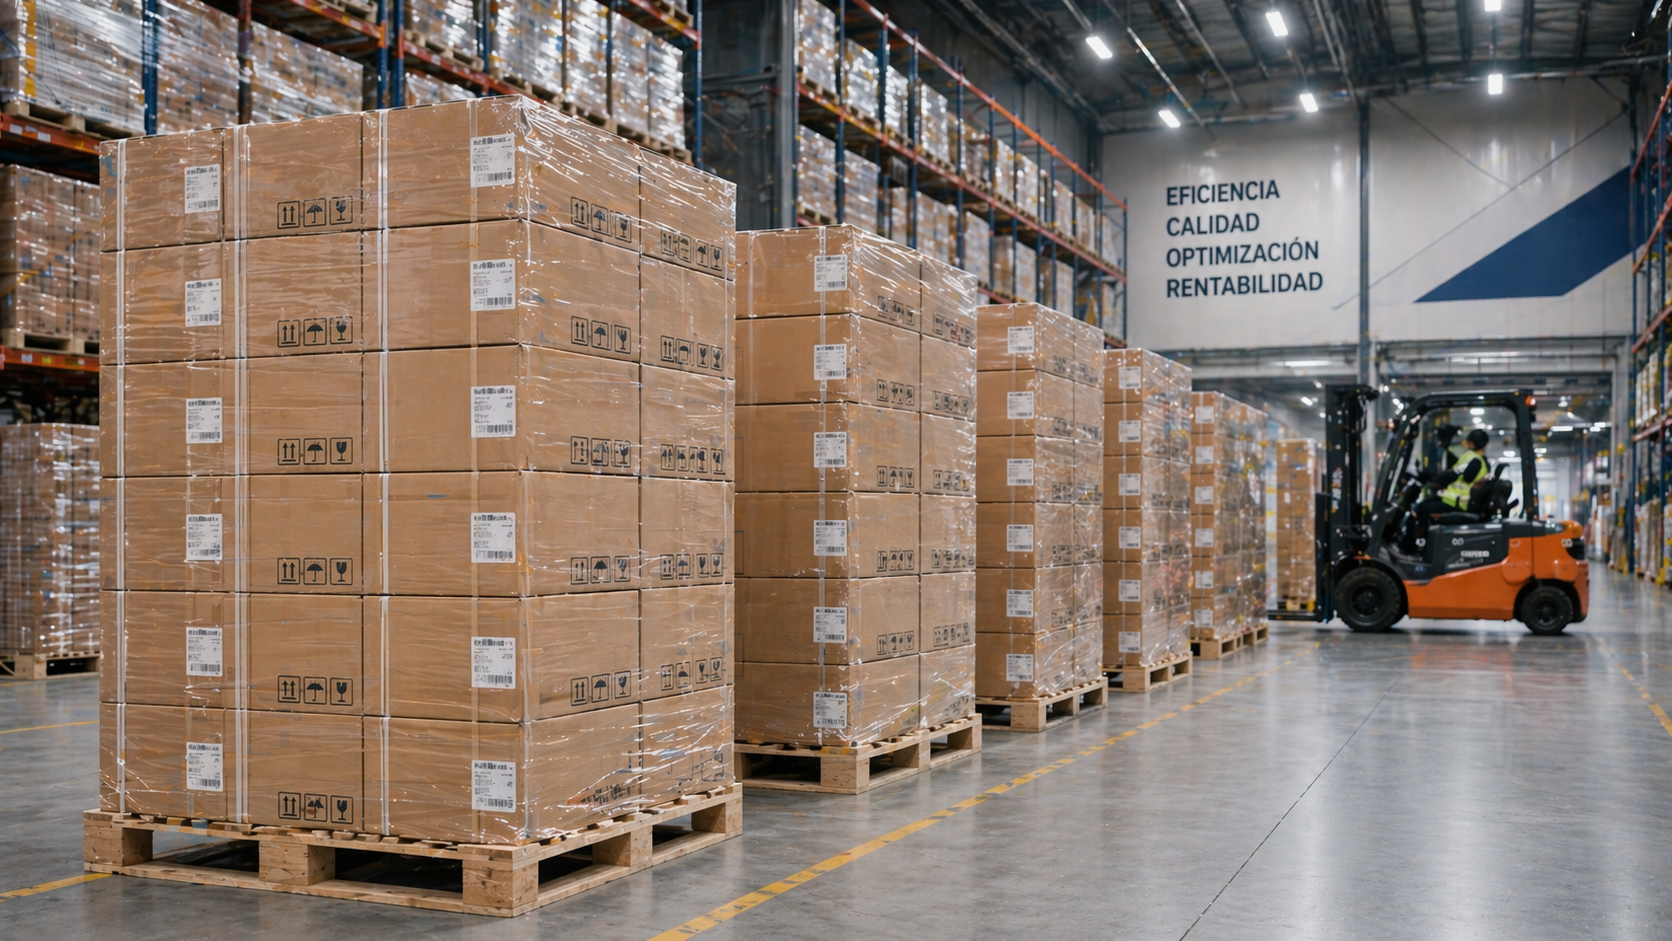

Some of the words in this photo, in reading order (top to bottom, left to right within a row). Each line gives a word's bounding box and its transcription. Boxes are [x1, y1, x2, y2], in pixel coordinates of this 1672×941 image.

[1166, 180, 1280, 206] EFICIENCIA
[1166, 212, 1260, 236] CALIDAD
[1166, 237, 1319, 267] OPTIMIZACIÓN
[1166, 272, 1323, 298] RENTABILIDAD
